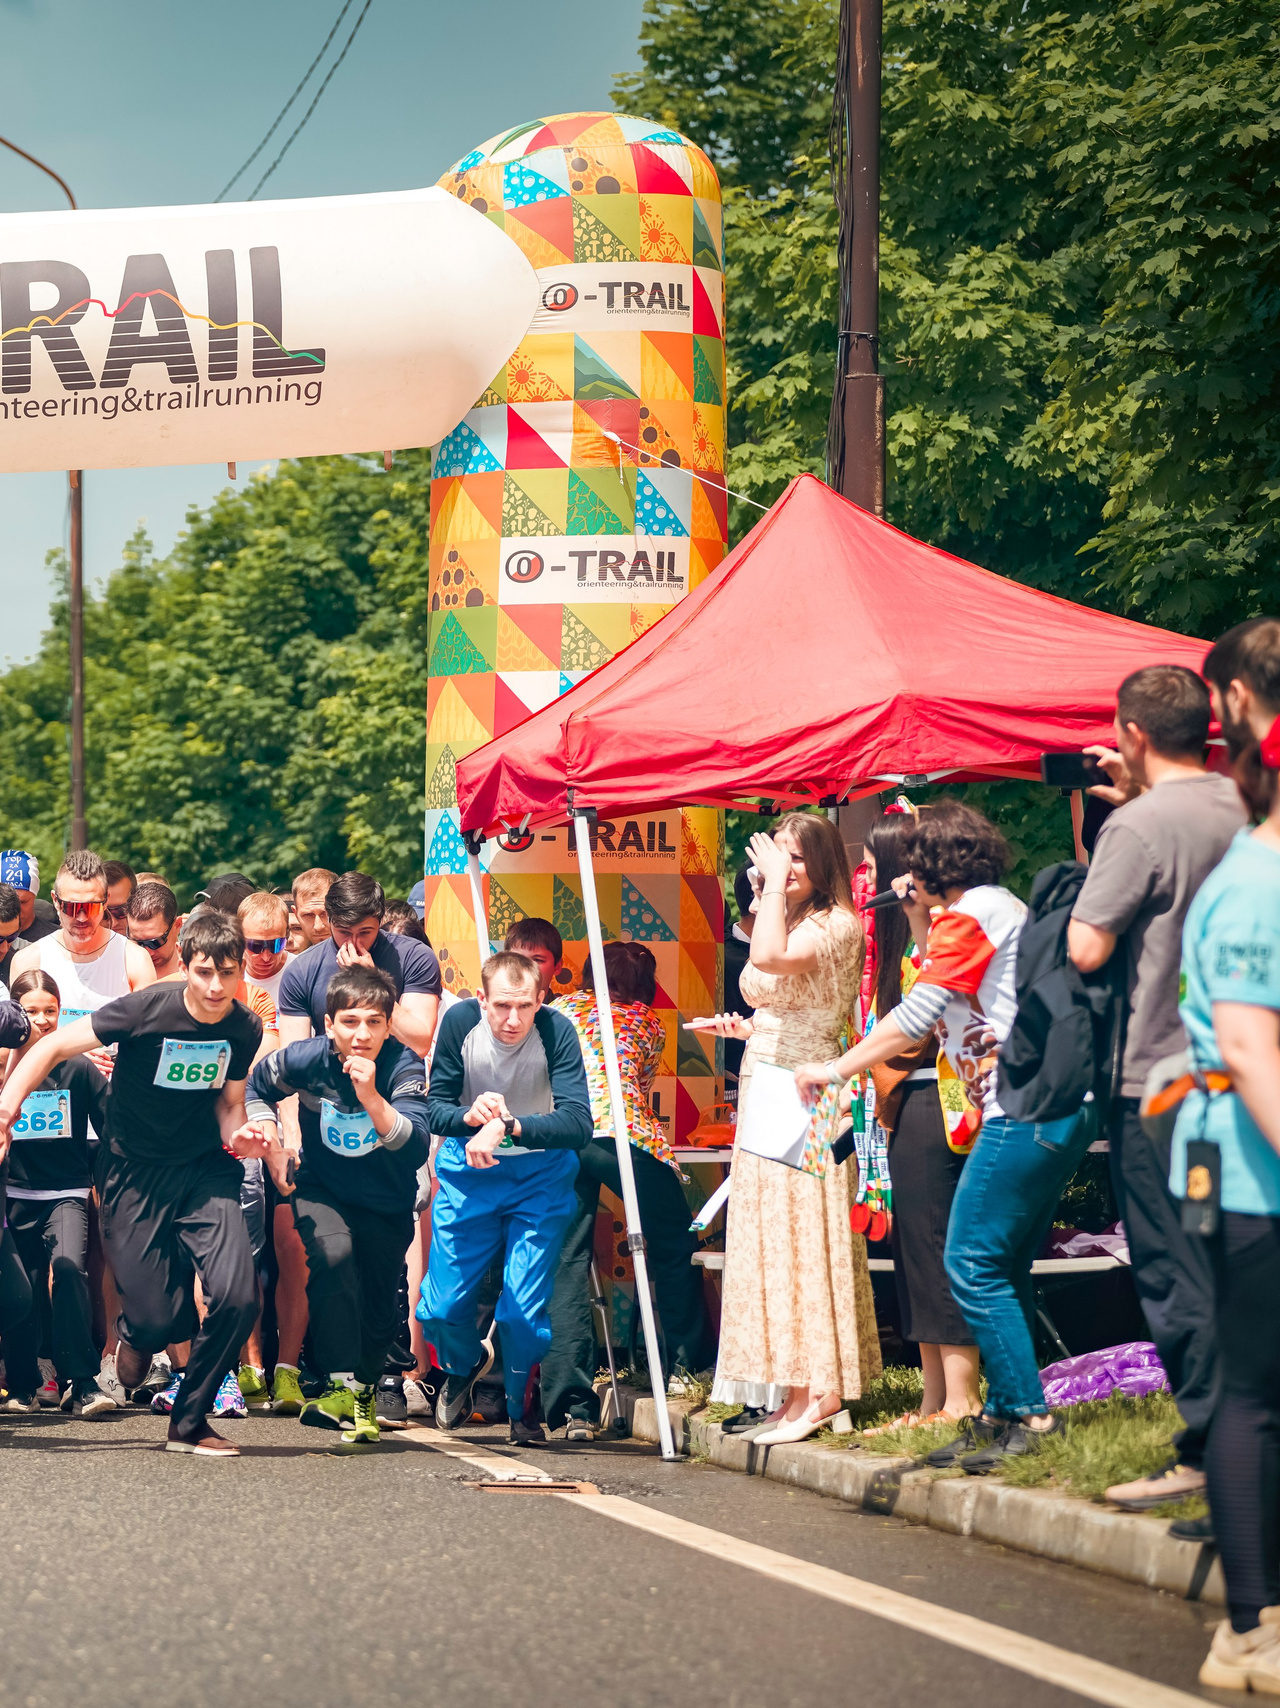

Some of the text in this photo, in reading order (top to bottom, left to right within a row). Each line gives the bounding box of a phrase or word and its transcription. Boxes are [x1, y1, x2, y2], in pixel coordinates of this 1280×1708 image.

[606, 307, 690, 318] orienteering&trailrunning
[577, 580, 684, 590] orienteering&trailrunning
[567, 850, 676, 860] orteering&trailrunning
[166, 1062, 219, 1083] 869
[13, 1110, 64, 1133] 662
[327, 1126, 379, 1150] 664
